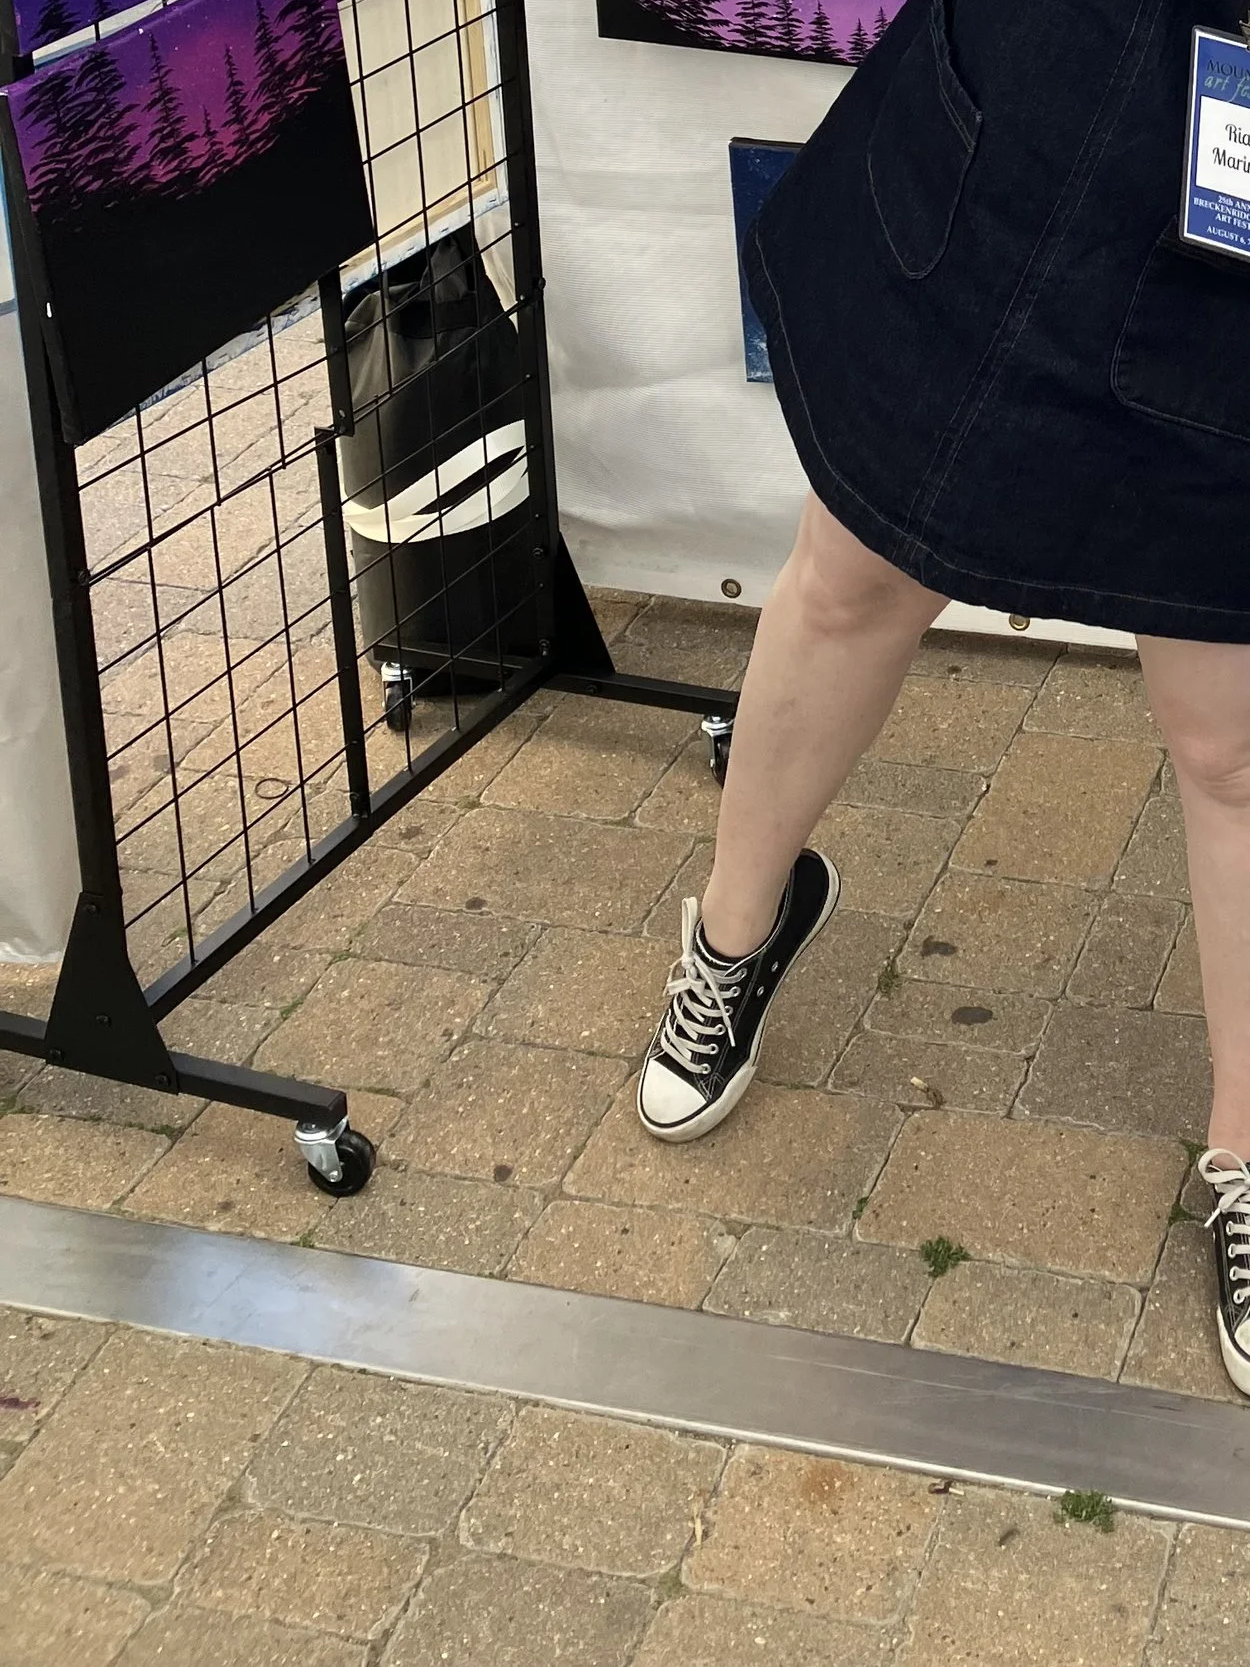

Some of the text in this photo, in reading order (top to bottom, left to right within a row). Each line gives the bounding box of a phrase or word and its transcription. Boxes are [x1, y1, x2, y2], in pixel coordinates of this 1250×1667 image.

[1204, 75, 1230, 92] art
[1215, 213, 1232, 224] ART
[1206, 225, 1240, 242] AUGUST
